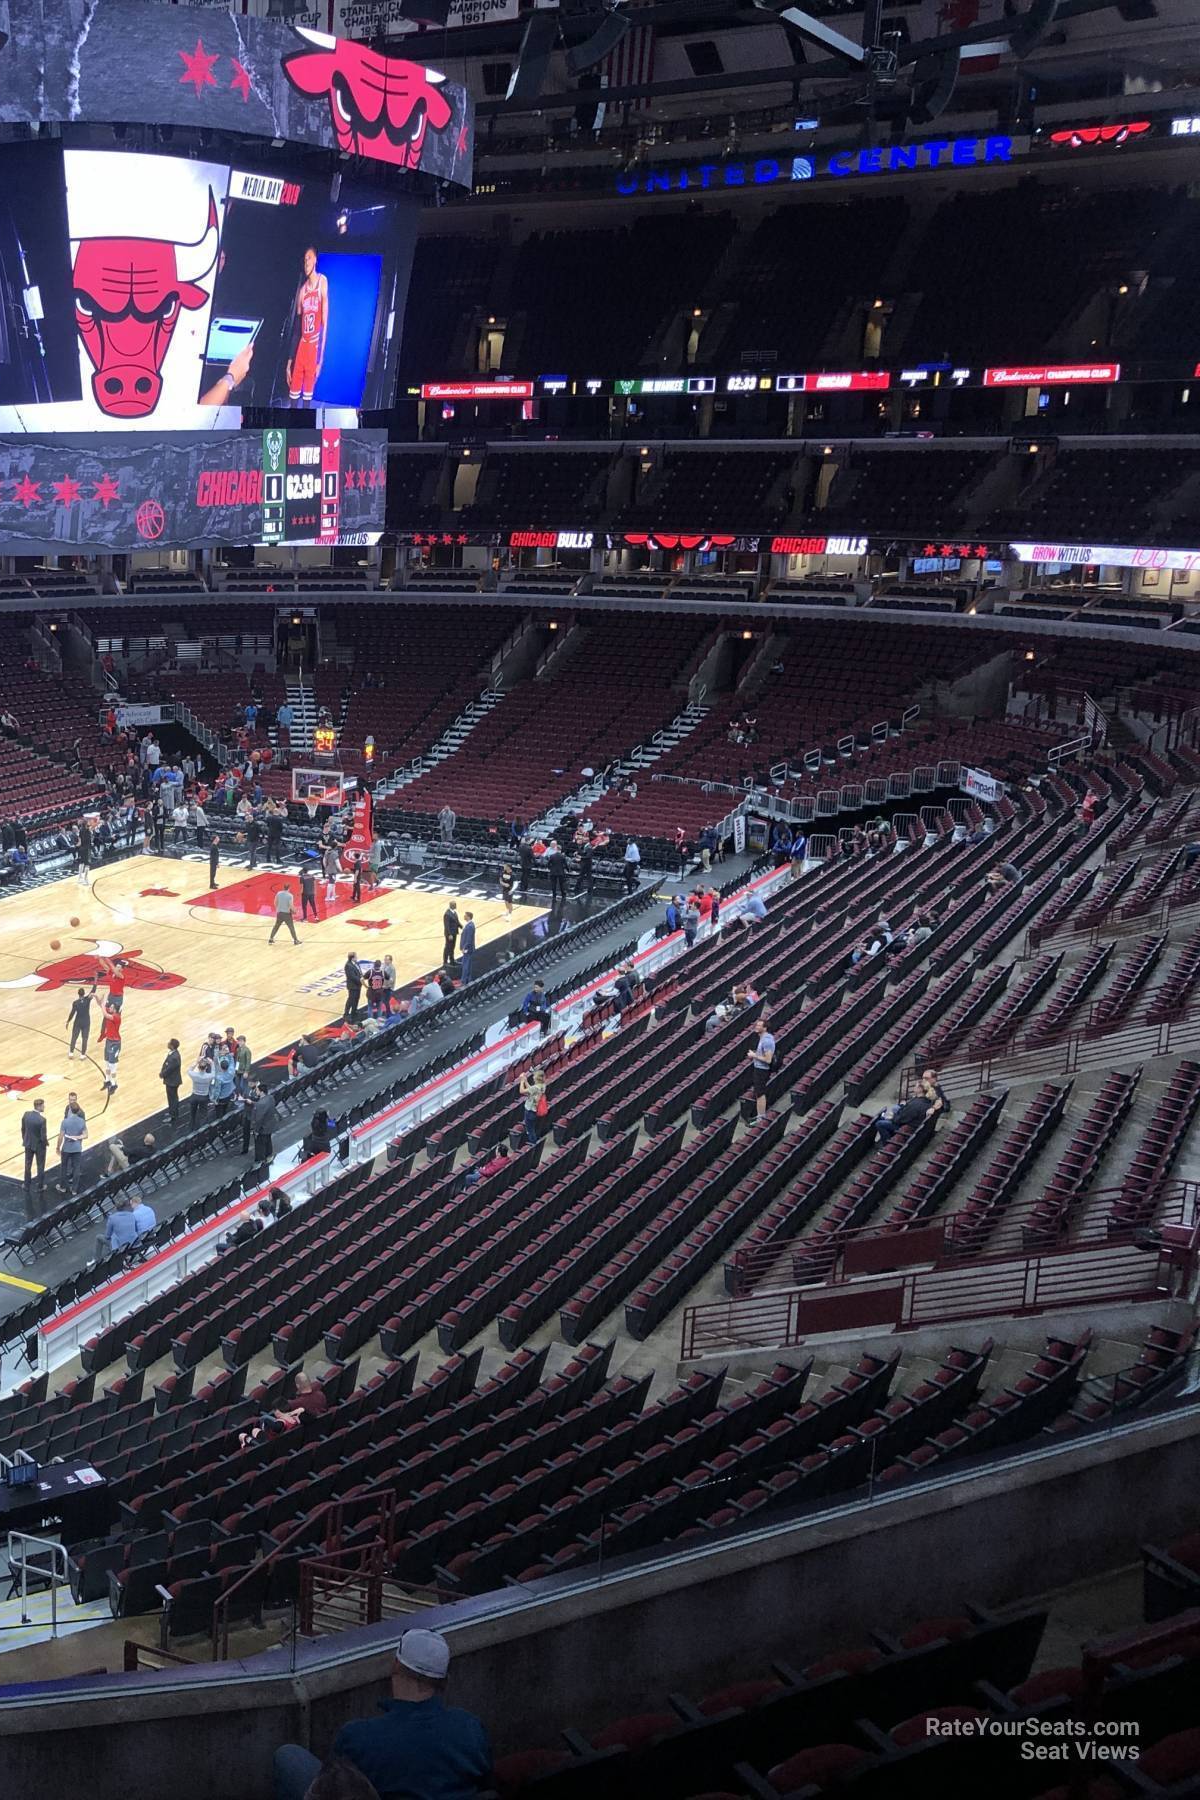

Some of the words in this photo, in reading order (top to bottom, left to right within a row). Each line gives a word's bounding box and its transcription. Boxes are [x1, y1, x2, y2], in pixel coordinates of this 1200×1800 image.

[340, 4, 384, 18] STANLEY
[449, 0, 507, 15] HAMPIONS
[462, 13, 486, 24] 1961
[615, 159, 780, 194] UNITED
[828, 135, 1013, 176] CENTER
[242, 176, 265, 198] MEDIA
[266, 180, 282, 201] DAY
[304, 313, 315, 333] 12
[993, 370, 1043, 382] Budweiser
[358, 533, 368, 544] US
[510, 533, 557, 547] CHICAGO
[557, 533, 593, 548] BULLS
[771, 536, 826, 554] CHICAGO
[826, 537, 868, 555] BULLS
[1032, 546, 1057, 560] GROW
[1057, 548, 1079, 562] WITH
[1079, 548, 1092, 562] US
[317, 739, 332, 750] 24
[349, 851, 369, 860] KA
